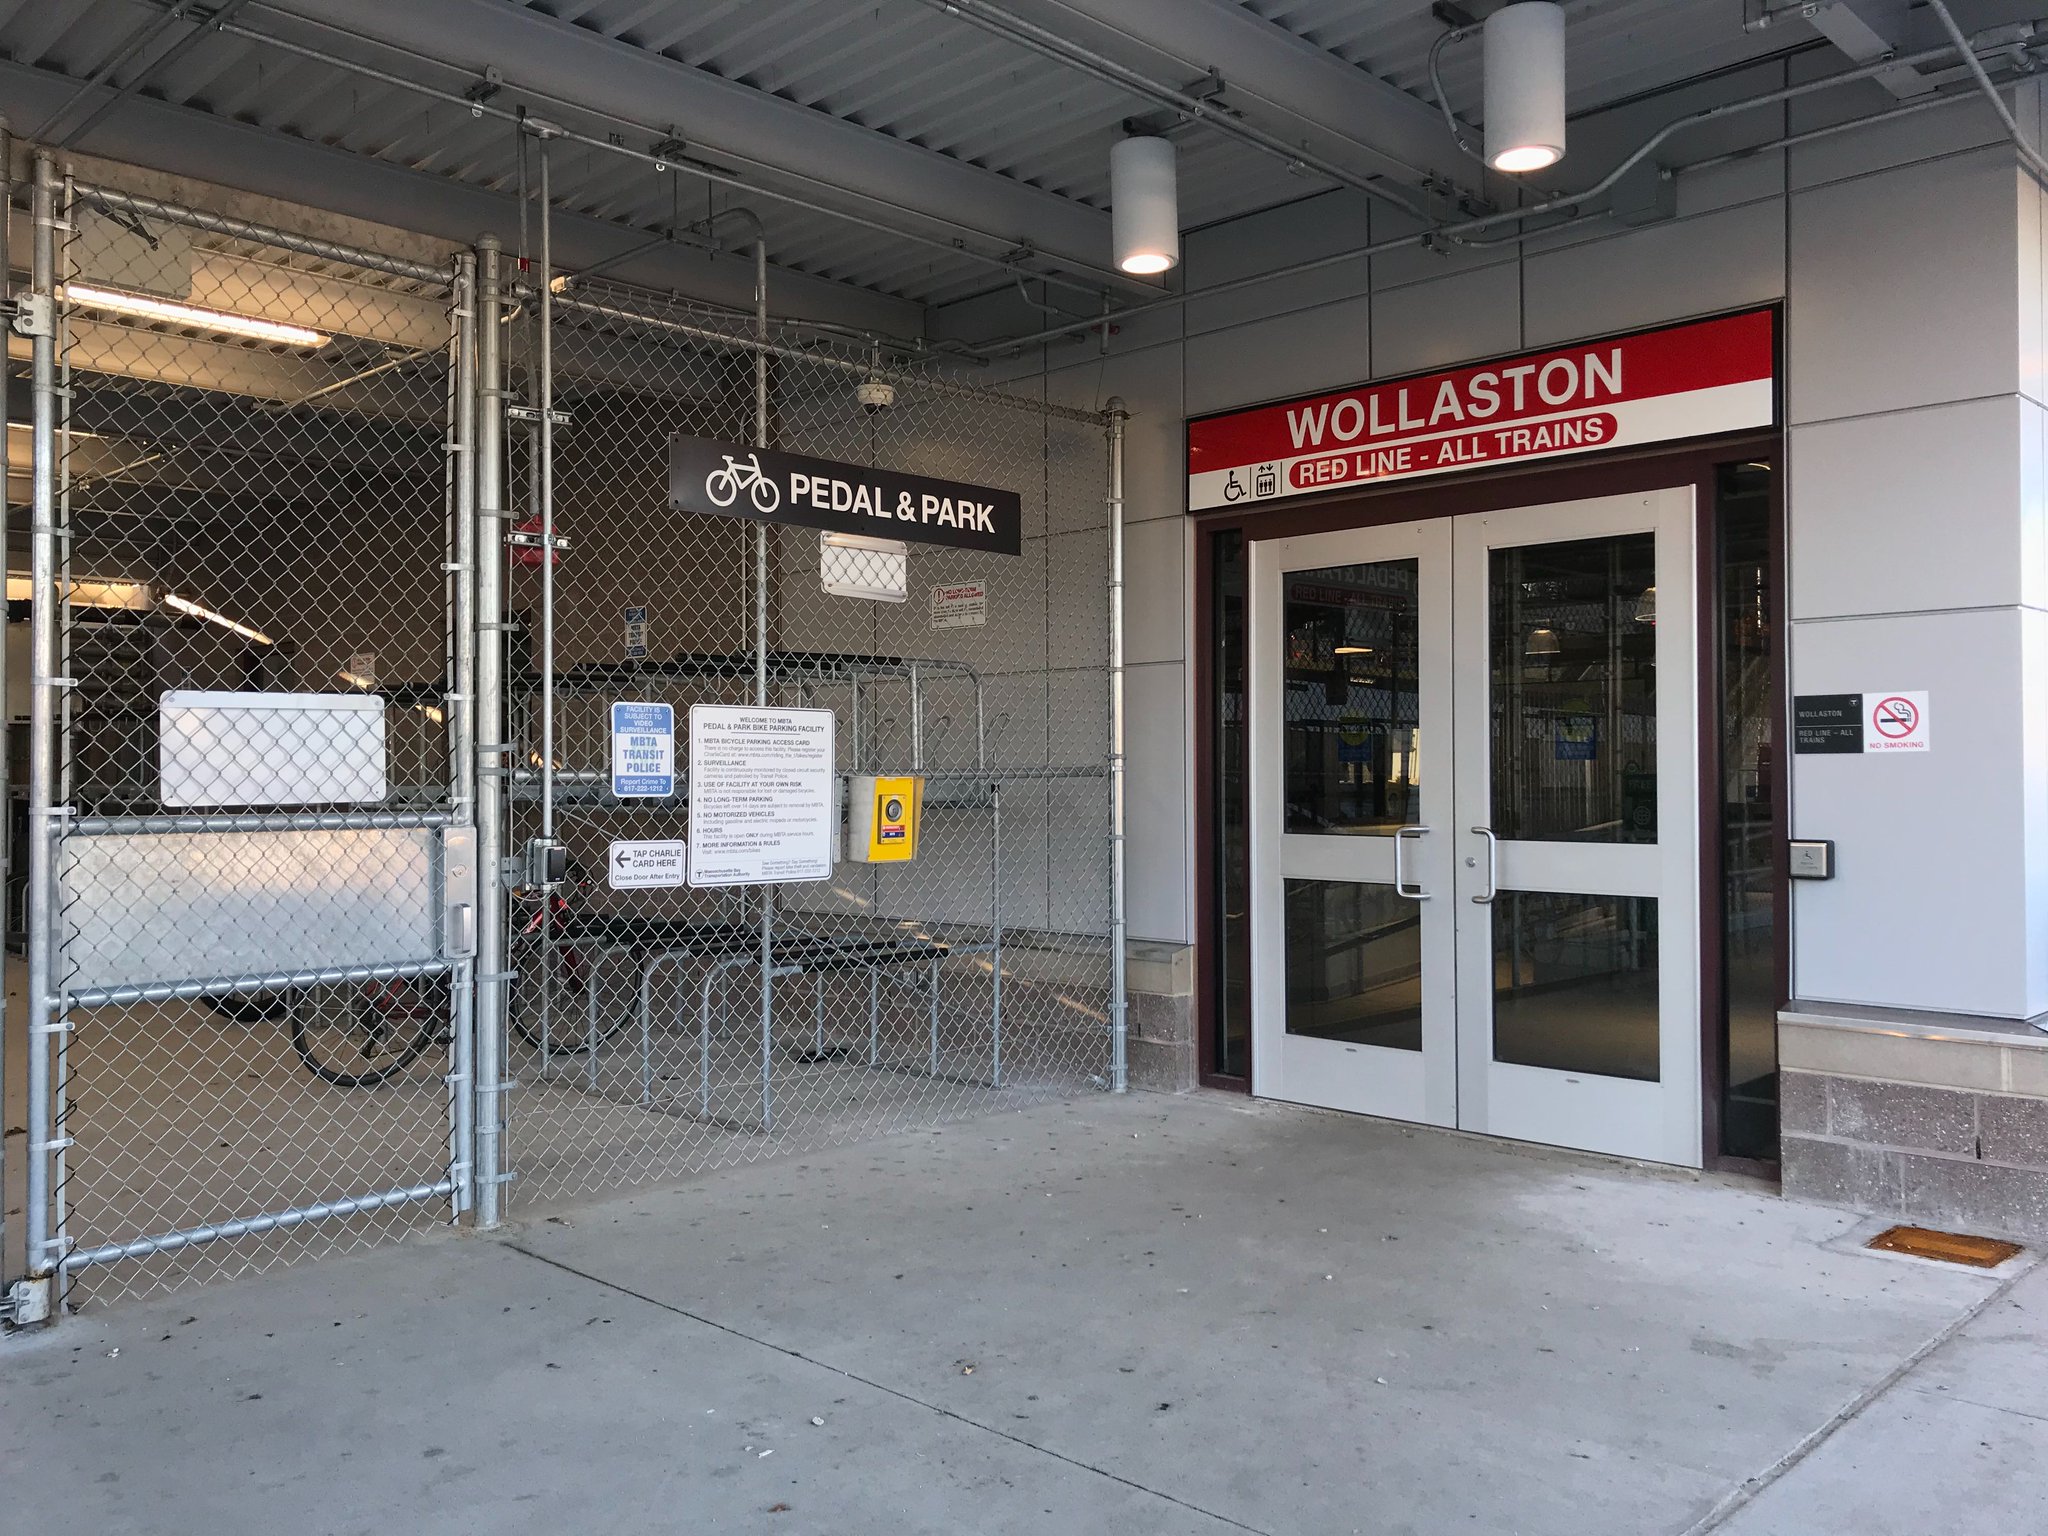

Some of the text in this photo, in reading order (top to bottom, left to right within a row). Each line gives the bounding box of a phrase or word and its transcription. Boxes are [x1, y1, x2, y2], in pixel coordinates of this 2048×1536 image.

[1287, 348, 1622, 449] WOLLASTON
[1299, 458, 1347, 486] RED
[1356, 448, 1412, 478] LINE
[1437, 435, 1487, 464] ALL
[1494, 418, 1603, 453] TRAINS
[790, 473, 996, 534] PEDAL & PARK
[630, 737, 657, 746] MBTA
[623, 750, 664, 759] TRANSIT
[627, 763, 660, 772] POLICE
[649, 849, 681, 857] CHARLIE
